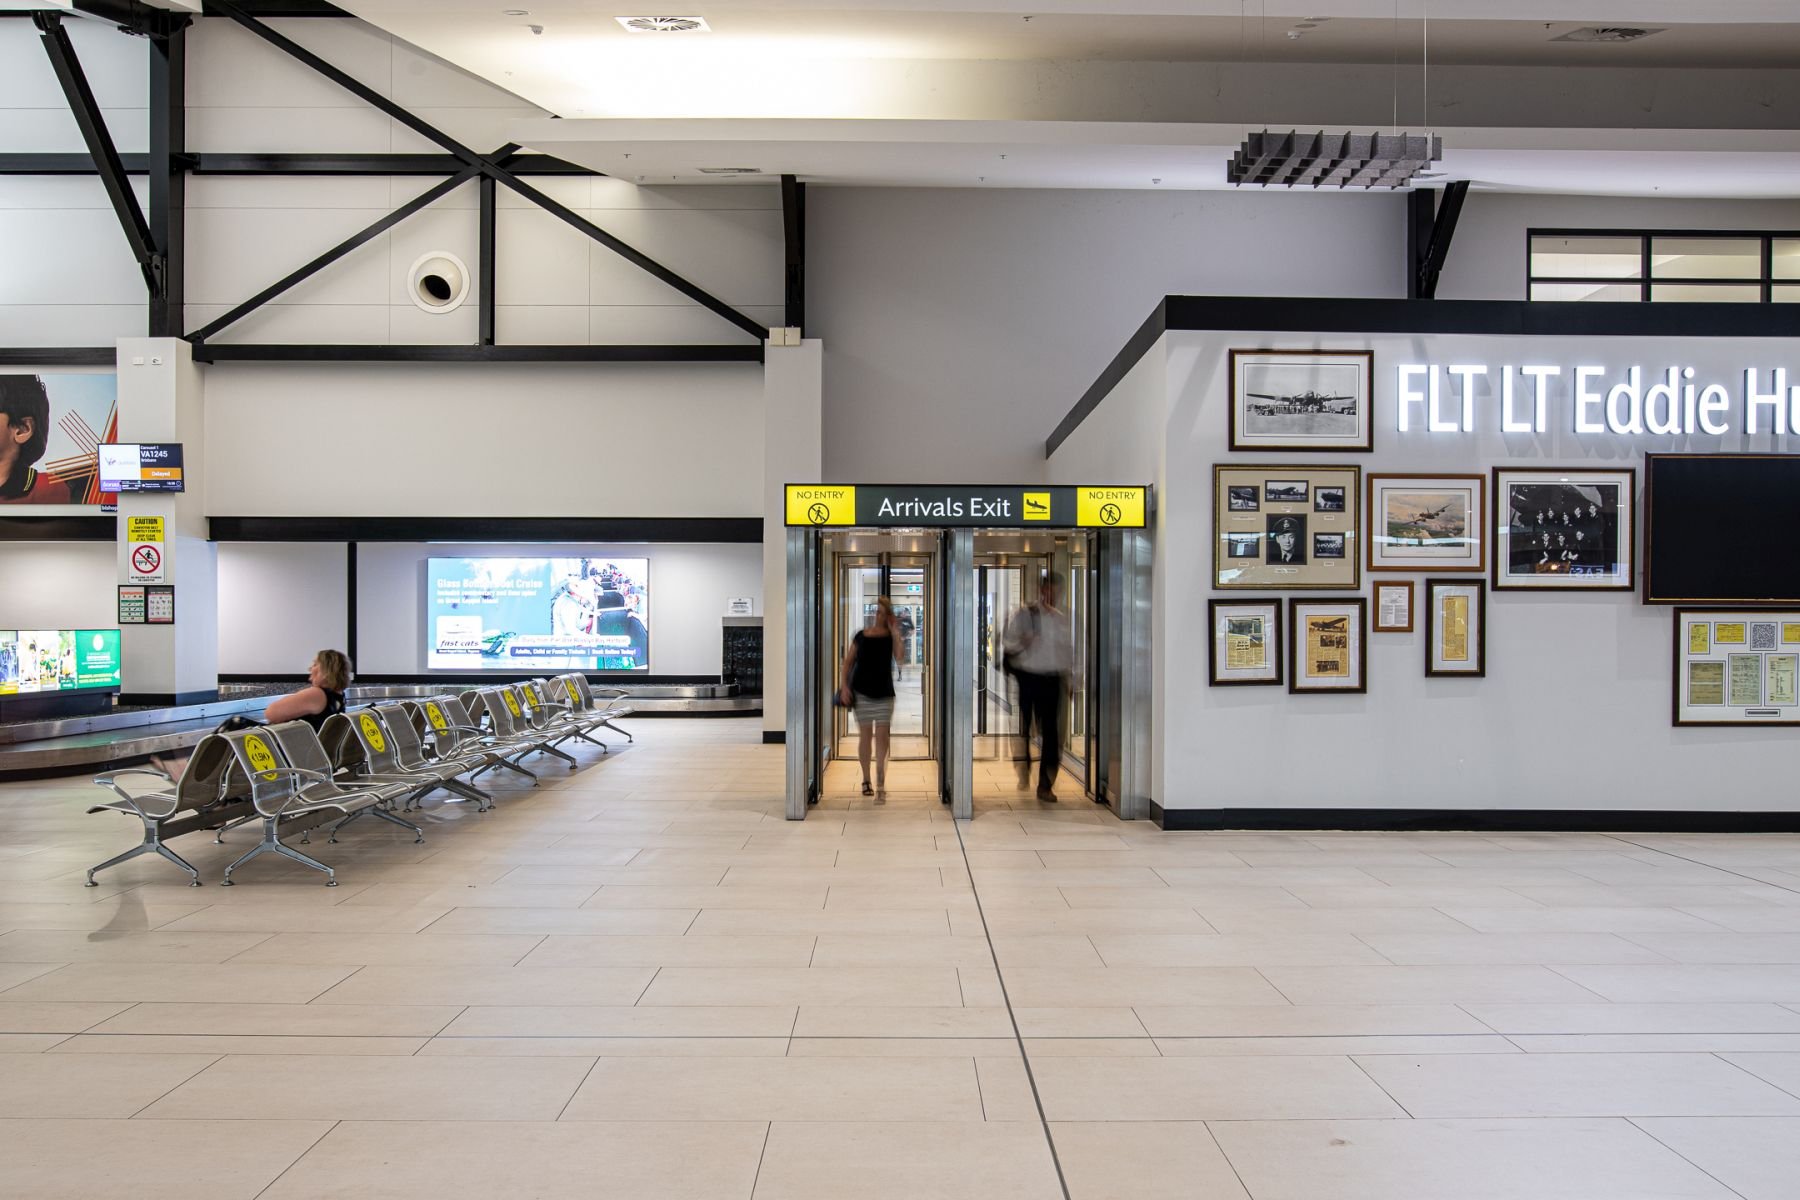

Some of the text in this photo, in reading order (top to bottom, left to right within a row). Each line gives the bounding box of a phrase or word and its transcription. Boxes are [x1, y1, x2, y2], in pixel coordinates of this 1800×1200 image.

[1397, 364, 1488, 432] FLT
[1500, 365, 1561, 432] LT
[1574, 366, 1729, 435] Eddie
[140, 450, 168, 458] VA1245
[796, 491, 845, 499] NO ENTRY
[1089, 491, 1136, 500] NO ENTRY
[878, 497, 1012, 517] Arrivals Exit
[437, 578, 461, 588] Glass
[516, 579, 543, 588] Cruise
